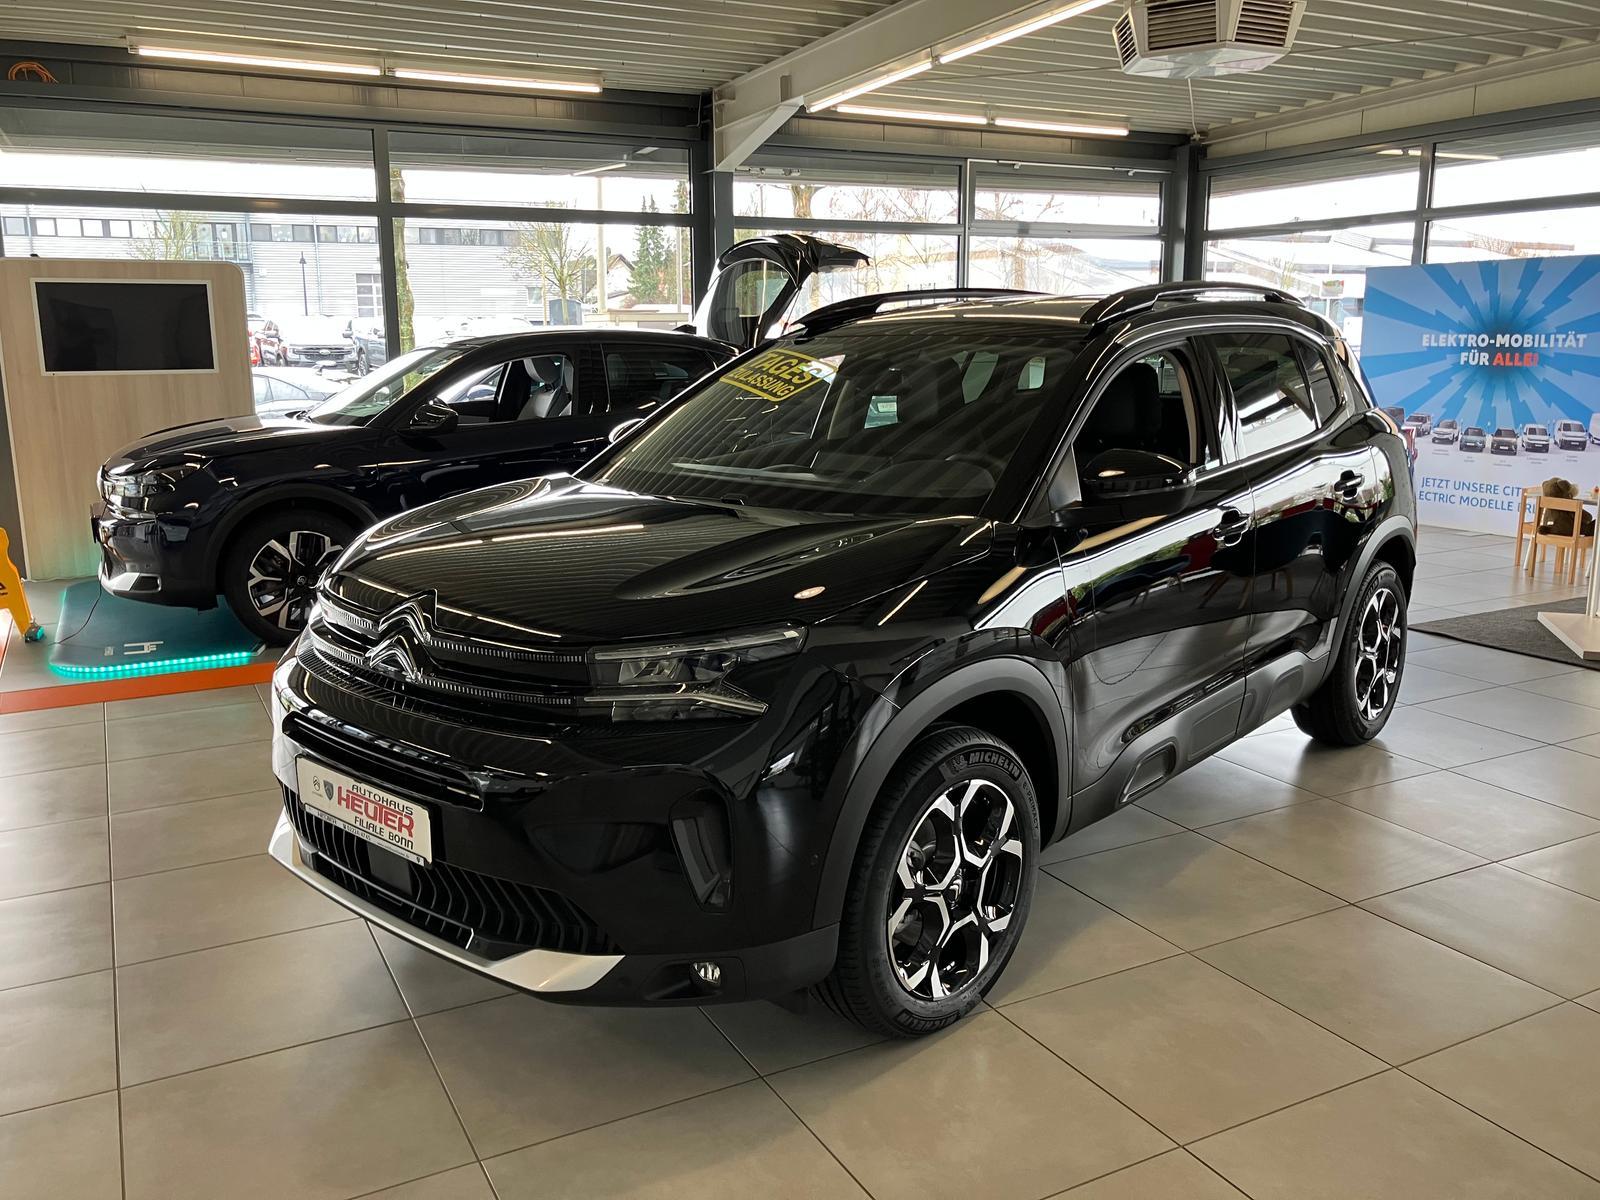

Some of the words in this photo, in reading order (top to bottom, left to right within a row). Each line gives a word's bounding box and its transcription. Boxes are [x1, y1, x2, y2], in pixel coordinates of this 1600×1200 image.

[1422, 332, 1587, 348] ELEKTRO-MOBILITÄT
[751, 353, 822, 384] TAGES
[1460, 350, 1489, 366] FÜR
[1492, 353, 1539, 367] ALLE!
[731, 367, 795, 396] ZULASSUNG
[1421, 477, 1451, 489] JETZT
[1454, 481, 1499, 495] UNSERE
[1459, 496, 1514, 512] MODELLE
[969, 751, 1020, 778] MICHELIN
[337, 786, 415, 838] HEUTER
[351, 784, 414, 816] AUTOHAUS
[354, 815, 385, 837] FILIALE
[388, 831, 414, 850] BONN
